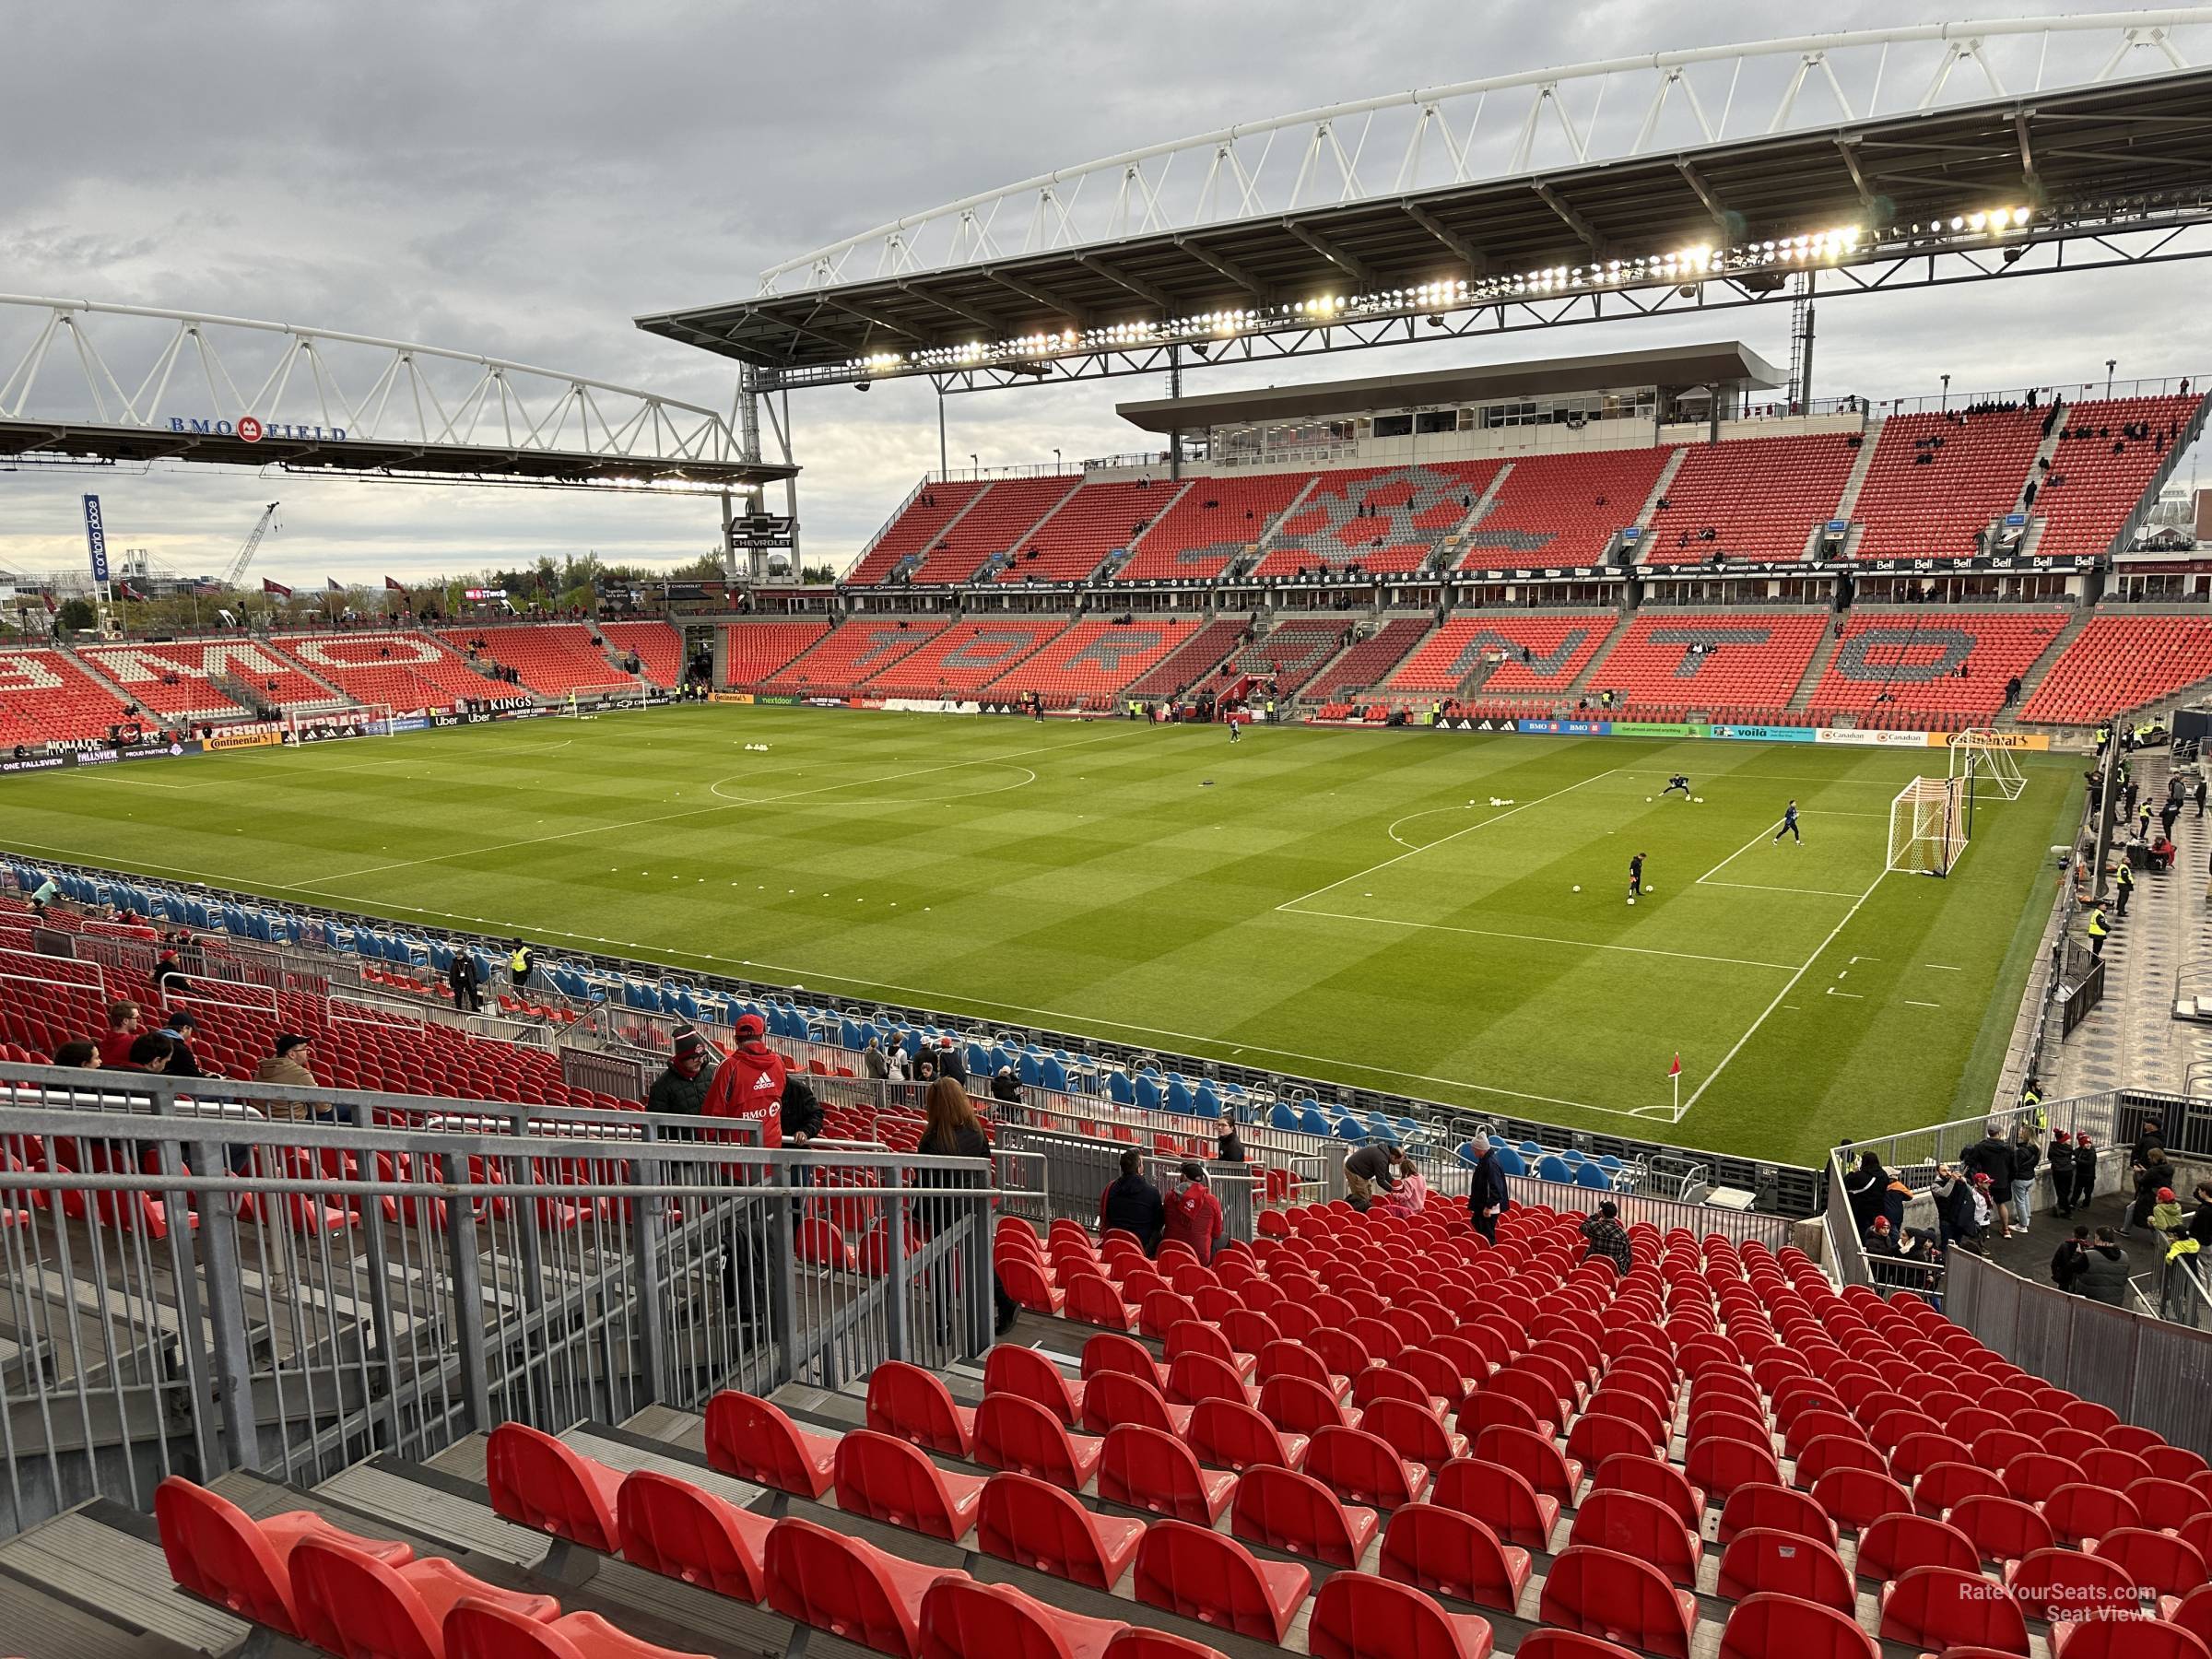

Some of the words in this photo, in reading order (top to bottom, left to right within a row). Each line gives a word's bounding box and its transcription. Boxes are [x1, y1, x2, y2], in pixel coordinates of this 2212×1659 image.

[170, 418, 232, 435] BMO
[266, 423, 347, 442] FIELD
[88, 500, 102, 530] place
[91, 532, 106, 567] ontario
[1877, 560, 1895, 570] Bell
[1915, 559, 1933, 569] Bell
[1954, 559, 1972, 568] Bell
[1993, 558, 2011, 567] Bell
[2033, 558, 2053, 567] Bell
[2075, 556, 2095, 566] Bell
[714, 693, 744, 701] Continental
[762, 697, 793, 705] nextdoor
[489, 696, 532, 711] KINGS
[435, 714, 458, 726] Uber
[468, 712, 490, 724] Uber
[1738, 728, 1767, 737] voilà
[1832, 731, 1864, 739] Canadian
[1888, 733, 1921, 741] Canadian
[210, 735, 261, 749] Continental
[1946, 733, 2017, 747] Continental
[77, 749, 119, 762] FALLSVIEW
[145, 747, 168, 756] PARTNER
[4, 762, 20, 771] ONE
[21, 758, 64, 769] FALLSVIEW
[753, 1081, 775, 1090] adidas
[741, 1109, 767, 1122] BMO
